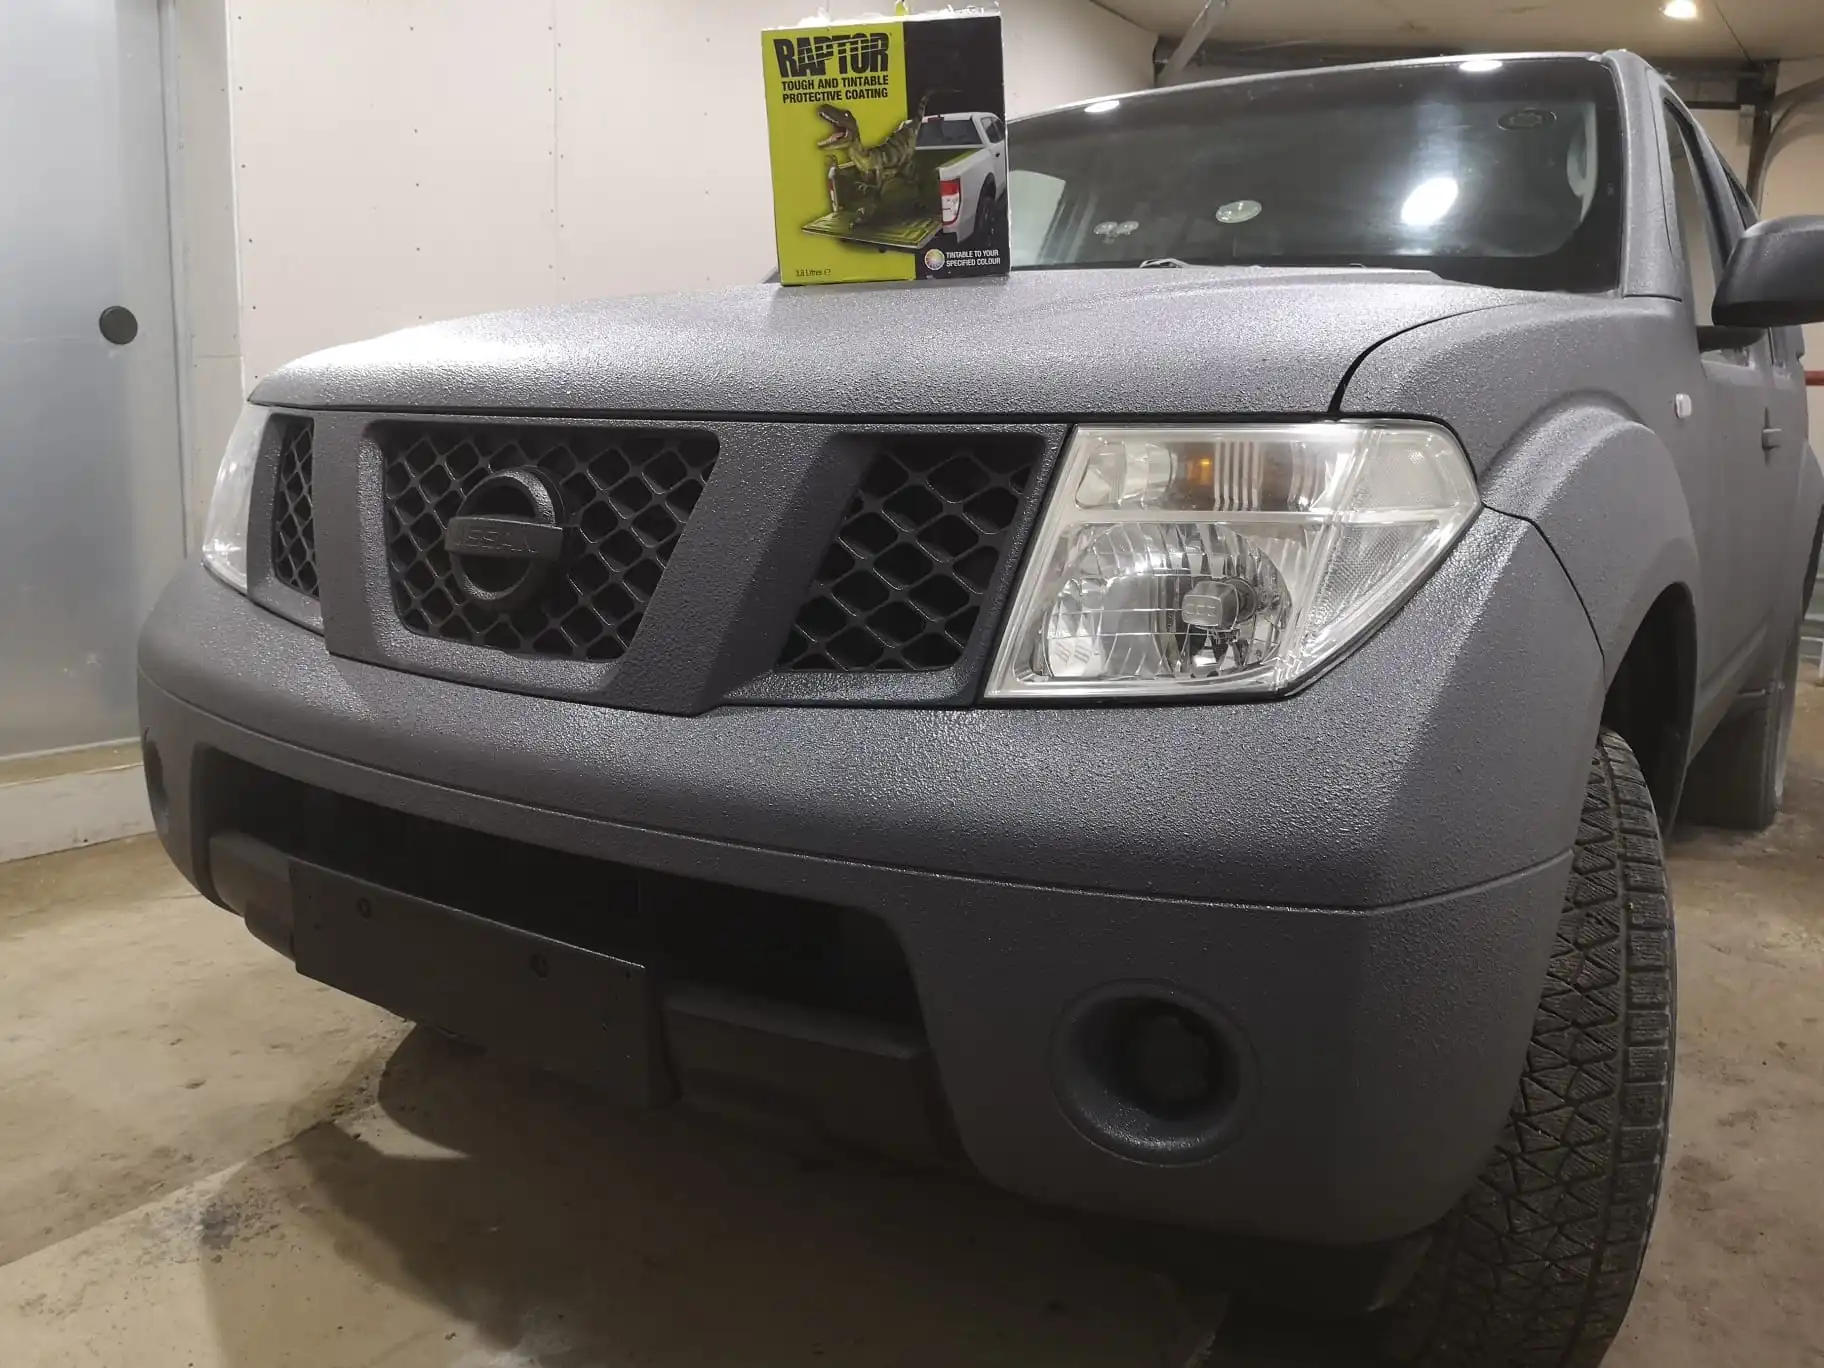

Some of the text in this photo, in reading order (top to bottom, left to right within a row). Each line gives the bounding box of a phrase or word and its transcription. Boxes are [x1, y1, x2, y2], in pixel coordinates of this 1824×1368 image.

[773, 33, 889, 77] RAPTOR
[781, 75, 889, 91] TOUGH AND TINTABLE
[782, 88, 888, 103] PROTECTIVE COATING
[946, 251, 973, 259] TINTABLE
[974, 250, 982, 258] TO
[946, 259, 976, 267] SPECIFIED
